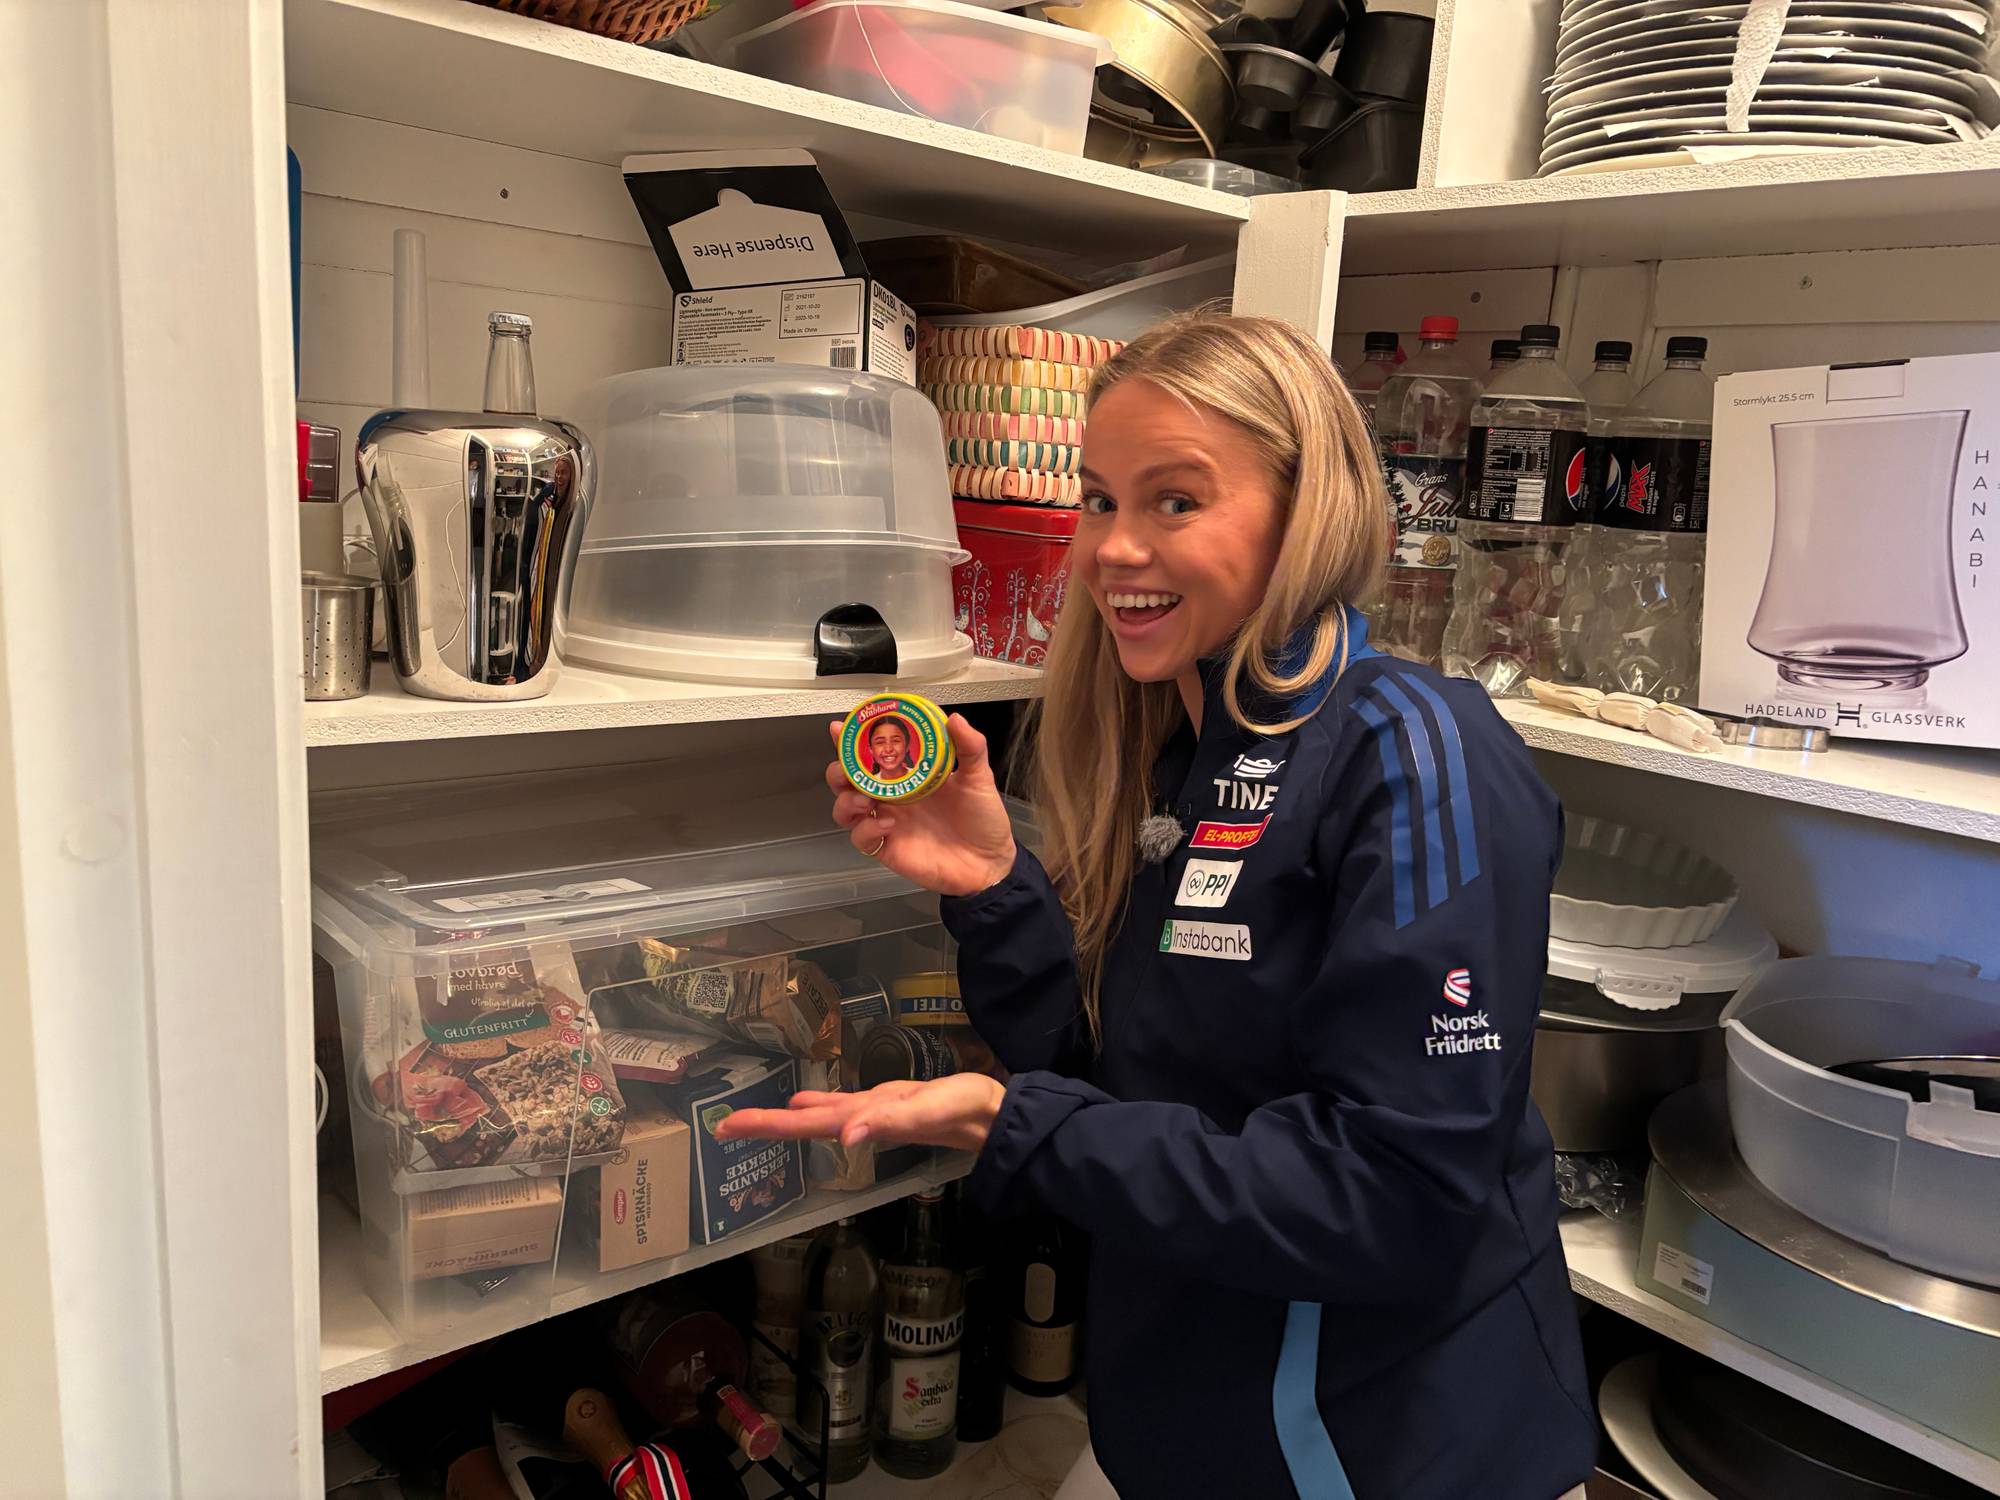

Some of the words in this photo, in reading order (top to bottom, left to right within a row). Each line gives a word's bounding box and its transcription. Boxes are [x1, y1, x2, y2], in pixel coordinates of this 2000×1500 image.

[692, 243, 734, 258] Here
[736, 234, 814, 253] Dispense
[691, 296, 713, 305] Shield
[873, 283, 897, 311] DK01BL
[1733, 395, 1776, 406] Stormlykt
[1414, 471, 1449, 487] Grans
[1626, 459, 1651, 514] MAX
[1401, 485, 1461, 528] Jul
[1504, 504, 1510, 512] 3
[1417, 519, 1457, 533] BRU
[1969, 450, 1989, 588] HANABI
[1745, 704, 1827, 719] HADELAND
[1871, 711, 1966, 729] GLASSVERK
[853, 770, 926, 796] GLUTENFRI
[1213, 778, 1279, 811] TINE
[1201, 874, 1232, 896] PPI
[1172, 926, 1250, 954] Instabank
[432, 962, 520, 980] rovbrød
[449, 981, 472, 991] med
[475, 980, 506, 991] havre
[444, 1018, 528, 1039] GLUTENFRITT
[1431, 1009, 1489, 1033] Norsk
[1425, 1032, 1502, 1056] Friidrett
[726, 1141, 785, 1180] KNEKKE
[720, 1150, 791, 1196] LEKSANDS
[616, 1192, 625, 1223] Semper
[632, 1159, 648, 1245] SPISKNÄCKE
[887, 1316, 962, 1345] MOLINAR
[903, 1377, 954, 1400] Sambuca
[921, 1395, 941, 1407] extra
